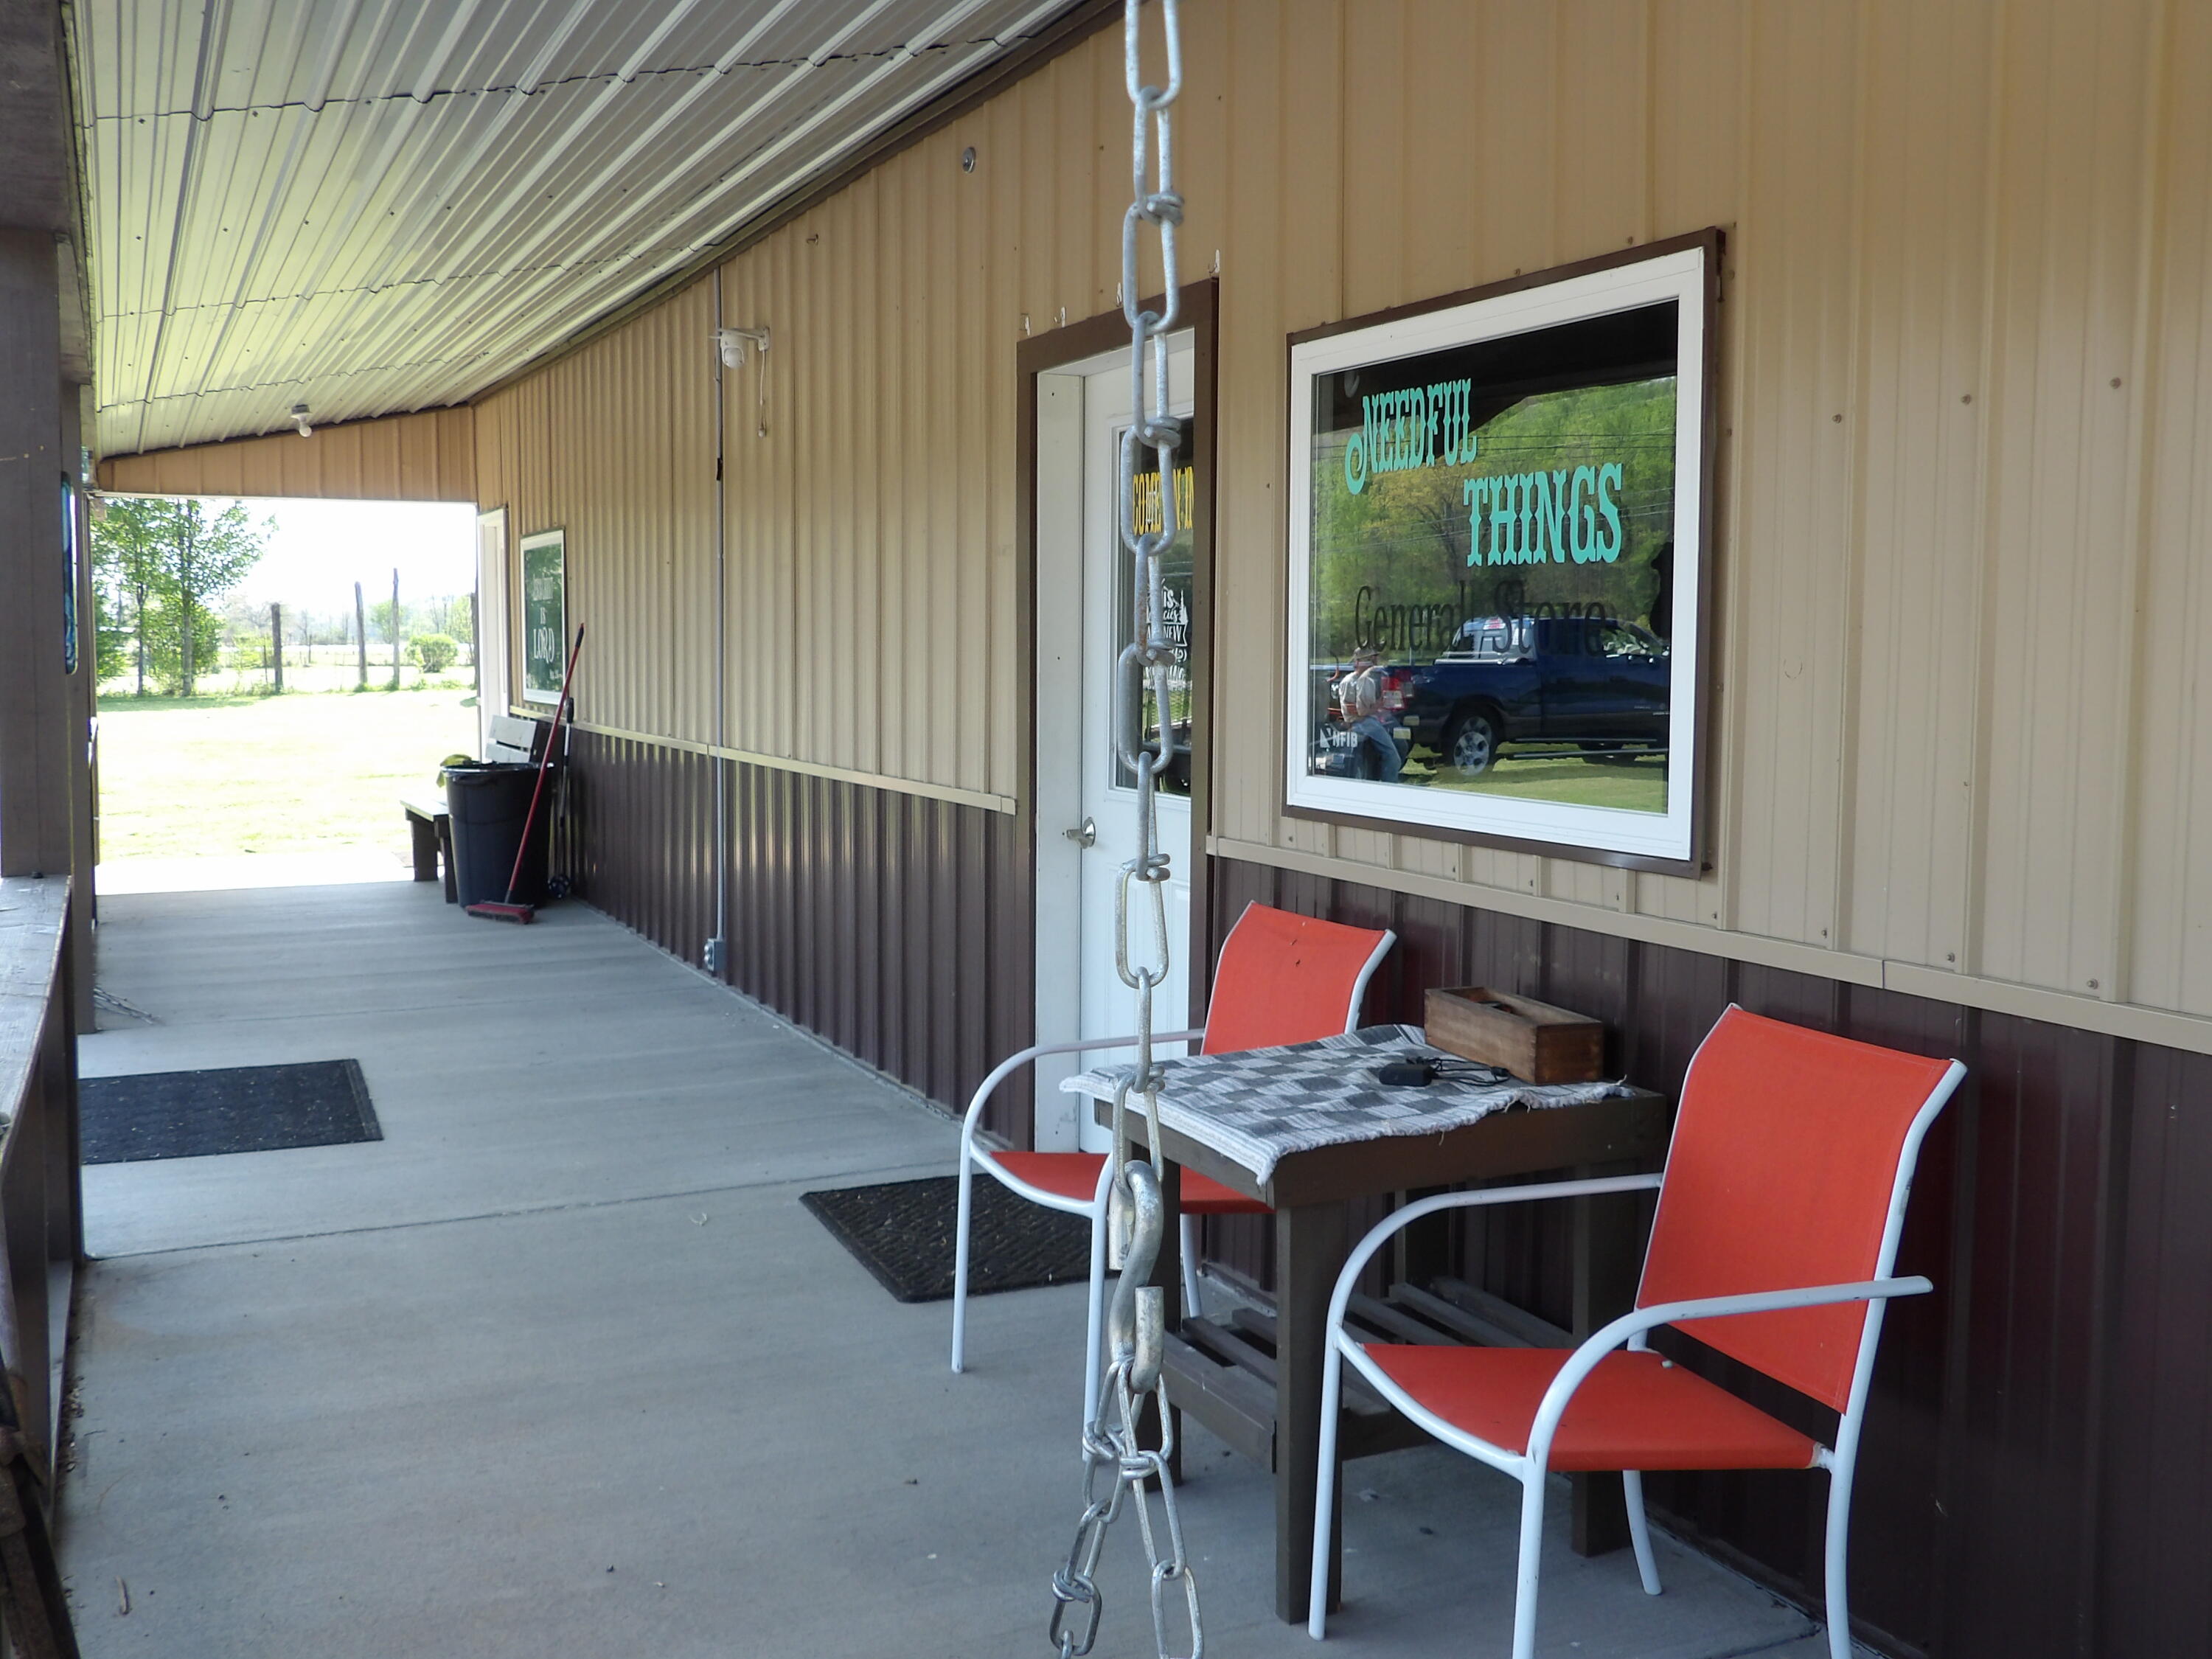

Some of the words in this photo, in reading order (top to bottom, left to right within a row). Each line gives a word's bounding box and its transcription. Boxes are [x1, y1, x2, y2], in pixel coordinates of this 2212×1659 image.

[1345, 378, 1478, 495] NEEDFUL
[1463, 462, 1623, 567] THINGS
[533, 627, 555, 664] LORD
[1355, 580, 1466, 652] General
[1493, 580, 1608, 657] Store
[1332, 731, 1358, 748] NFIB
